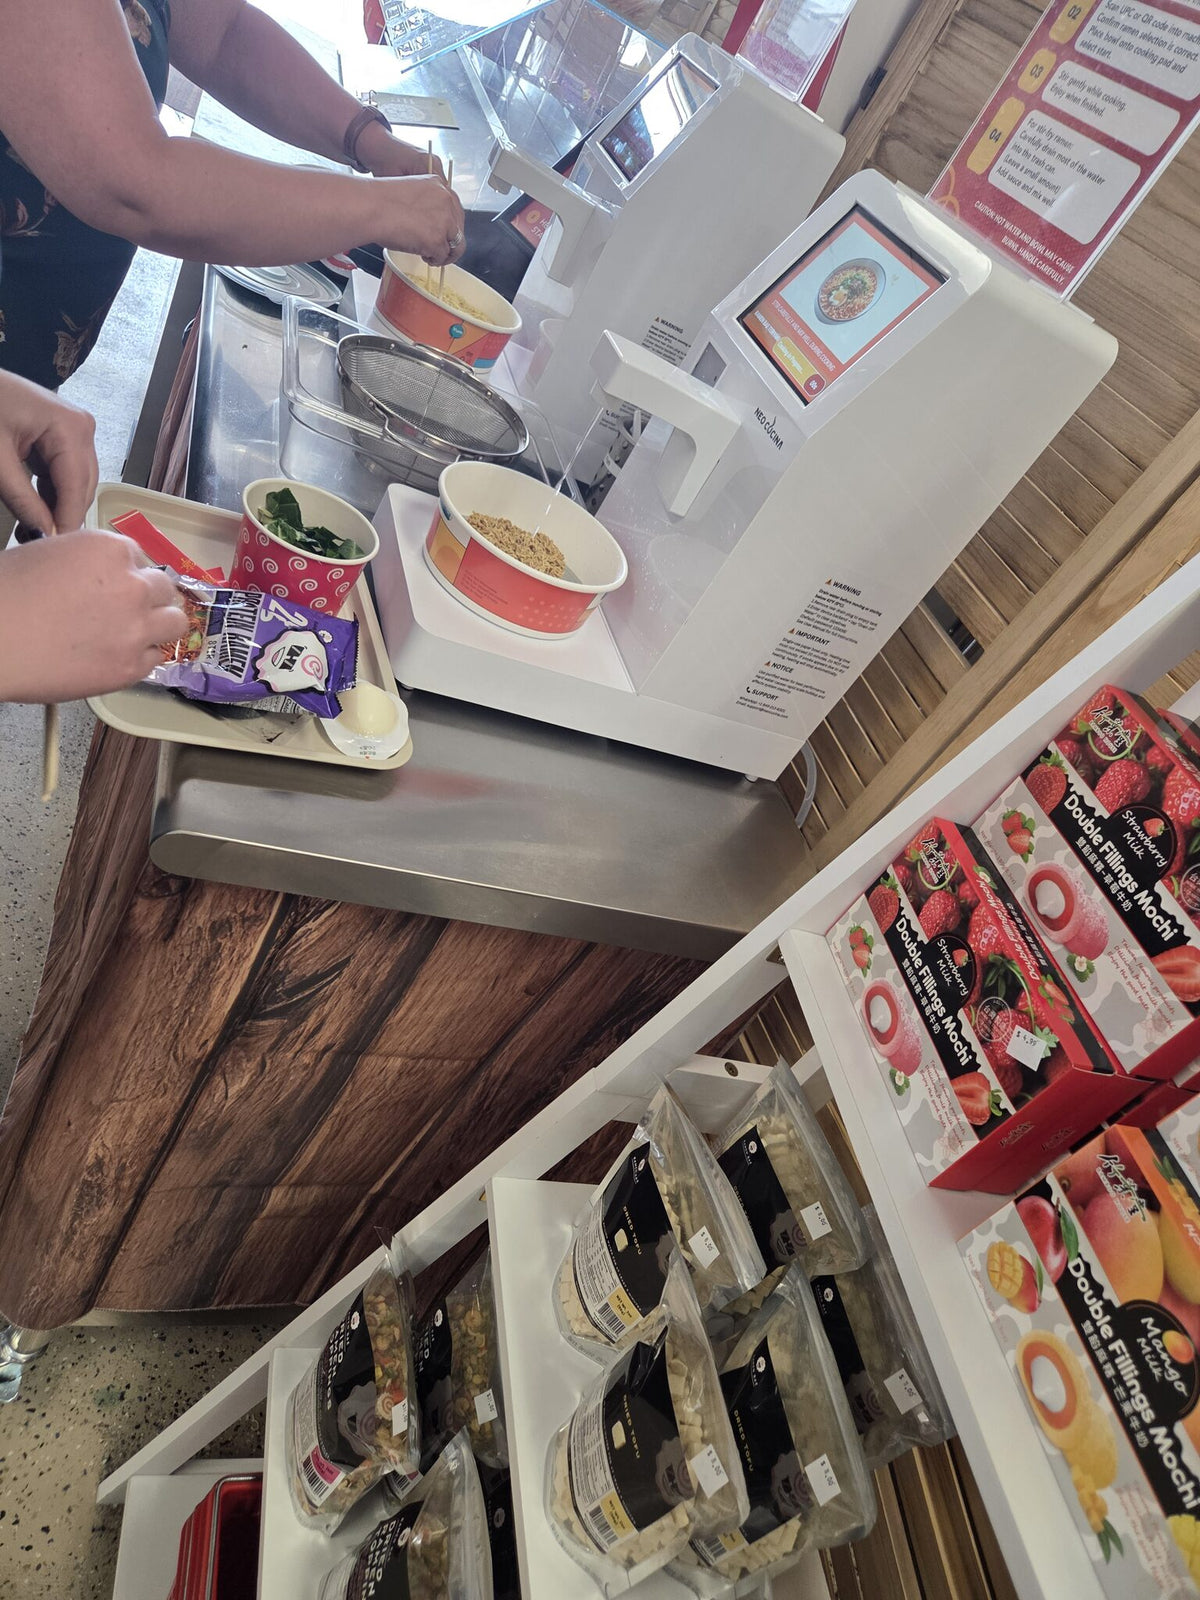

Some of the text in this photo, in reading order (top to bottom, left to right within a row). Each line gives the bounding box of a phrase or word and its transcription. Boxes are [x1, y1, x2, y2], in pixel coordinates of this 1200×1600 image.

[1067, 5, 1081, 20] 02
[1120, 4, 1136, 17] UPC
[1133, 12, 1141, 20] or
[1141, 13, 1154, 25] QR
[1152, 19, 1169, 31] code
[1168, 23, 1182, 37] into
[1181, 32, 1200, 46] mach
[1079, 40, 1098, 53] select
[1088, 24, 1188, 74] Place bowl onto cooking pad and
[1097, 12, 1199, 62] Confirm ramen selection is correct.
[1029, 65, 1044, 79] 03
[1059, 70, 1070, 80] Stir
[1067, 77, 1086, 92] gently
[1087, 84, 1103, 98] while
[1050, 82, 1066, 98] Enjoy
[1065, 92, 1083, 105] when
[989, 128, 1002, 143] 04
[1027, 118, 1038, 129] For
[1011, 142, 1022, 154] into
[1022, 148, 1032, 158] the
[1031, 154, 1046, 170] trash
[1020, 130, 1106, 186] Carefully drain most of the water
[996, 166, 1008, 178] Add
[1007, 173, 1022, 186] sauce
[1021, 182, 1033, 193] and
[1031, 188, 1043, 200] mix
[1024, 167, 1039, 180] small
[994, 215, 1006, 225] HOT
[1003, 219, 1021, 237] WATER
[1019, 232, 1032, 243] AND
[1030, 239, 1045, 254] BOWL
[1044, 249, 1057, 261] MAY
[1056, 257, 1075, 274] CAUSE
[1018, 247, 1039, 266] HANDLE
[754, 407, 783, 450] NEO CUCINA
[832, 580, 861, 596] WARNING
[795, 628, 830, 646] IMPORTANT
[770, 661, 794, 674] NOTICE
[750, 688, 778, 701] SUPPORT
[1121, 809, 1168, 868] Strawberry
[1123, 831, 1146, 860] Milk
[1064, 794, 1178, 941] Double Fillings Mochi
[976, 879, 998, 910] Mochi
[995, 909, 1017, 942] Fillings
[936, 959, 952, 987] Milk
[937, 938, 969, 996] Strawberry
[1015, 944, 1040, 980] Double
[895, 917, 923, 969] Double
[918, 964, 947, 1017] Fillings
[941, 1015, 973, 1066] Mochi
[623, 1206, 642, 1255] DRIED TOFU
[1136, 1337, 1163, 1382] Milk
[1140, 1316, 1189, 1397] Mango
[1067, 1257, 1113, 1340] Double
[1108, 1338, 1156, 1424] Fillings
[1149, 1425, 1200, 1510] Mochi
[630, 1429, 640, 1459] TOFU
[734, 1410, 754, 1472] DRIED TOFU
